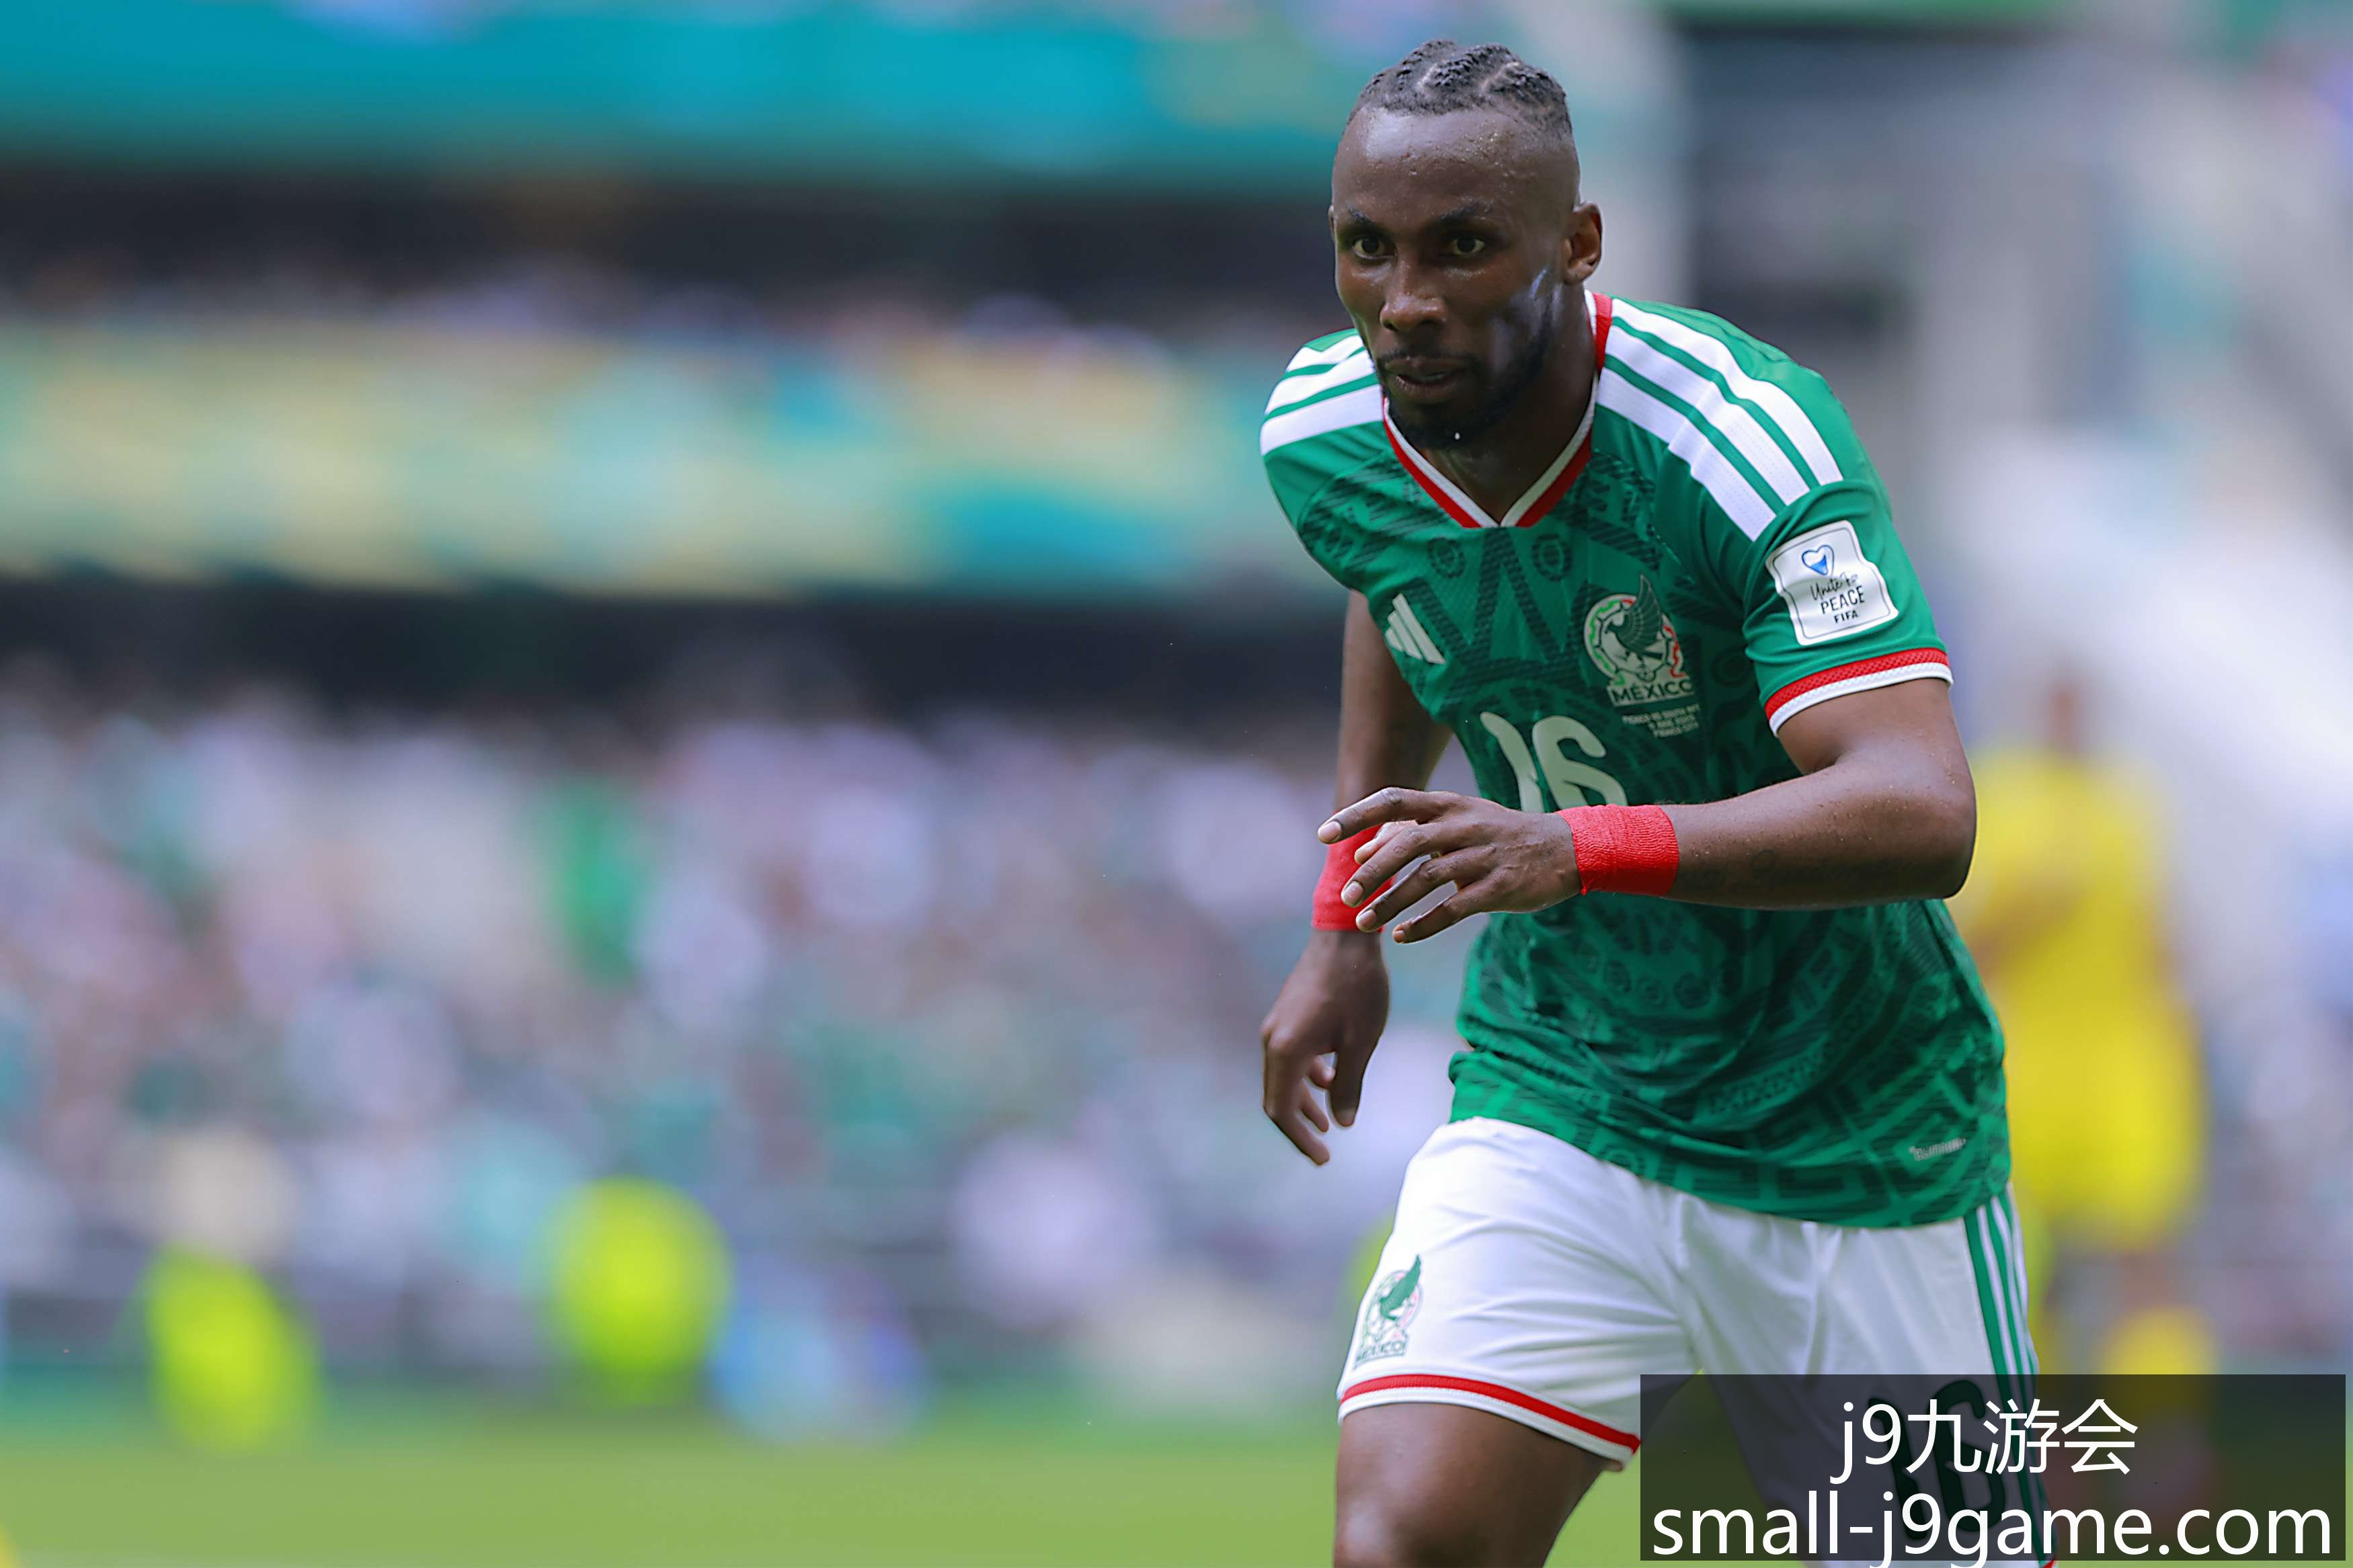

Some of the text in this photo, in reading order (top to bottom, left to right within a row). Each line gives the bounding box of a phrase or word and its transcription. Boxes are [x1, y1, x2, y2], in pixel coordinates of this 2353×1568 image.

[1810, 578, 1842, 601] Unite
[1821, 585, 1866, 615] PEACE
[1833, 610, 1859, 623] FIFA
[1480, 711, 1628, 813] 16
